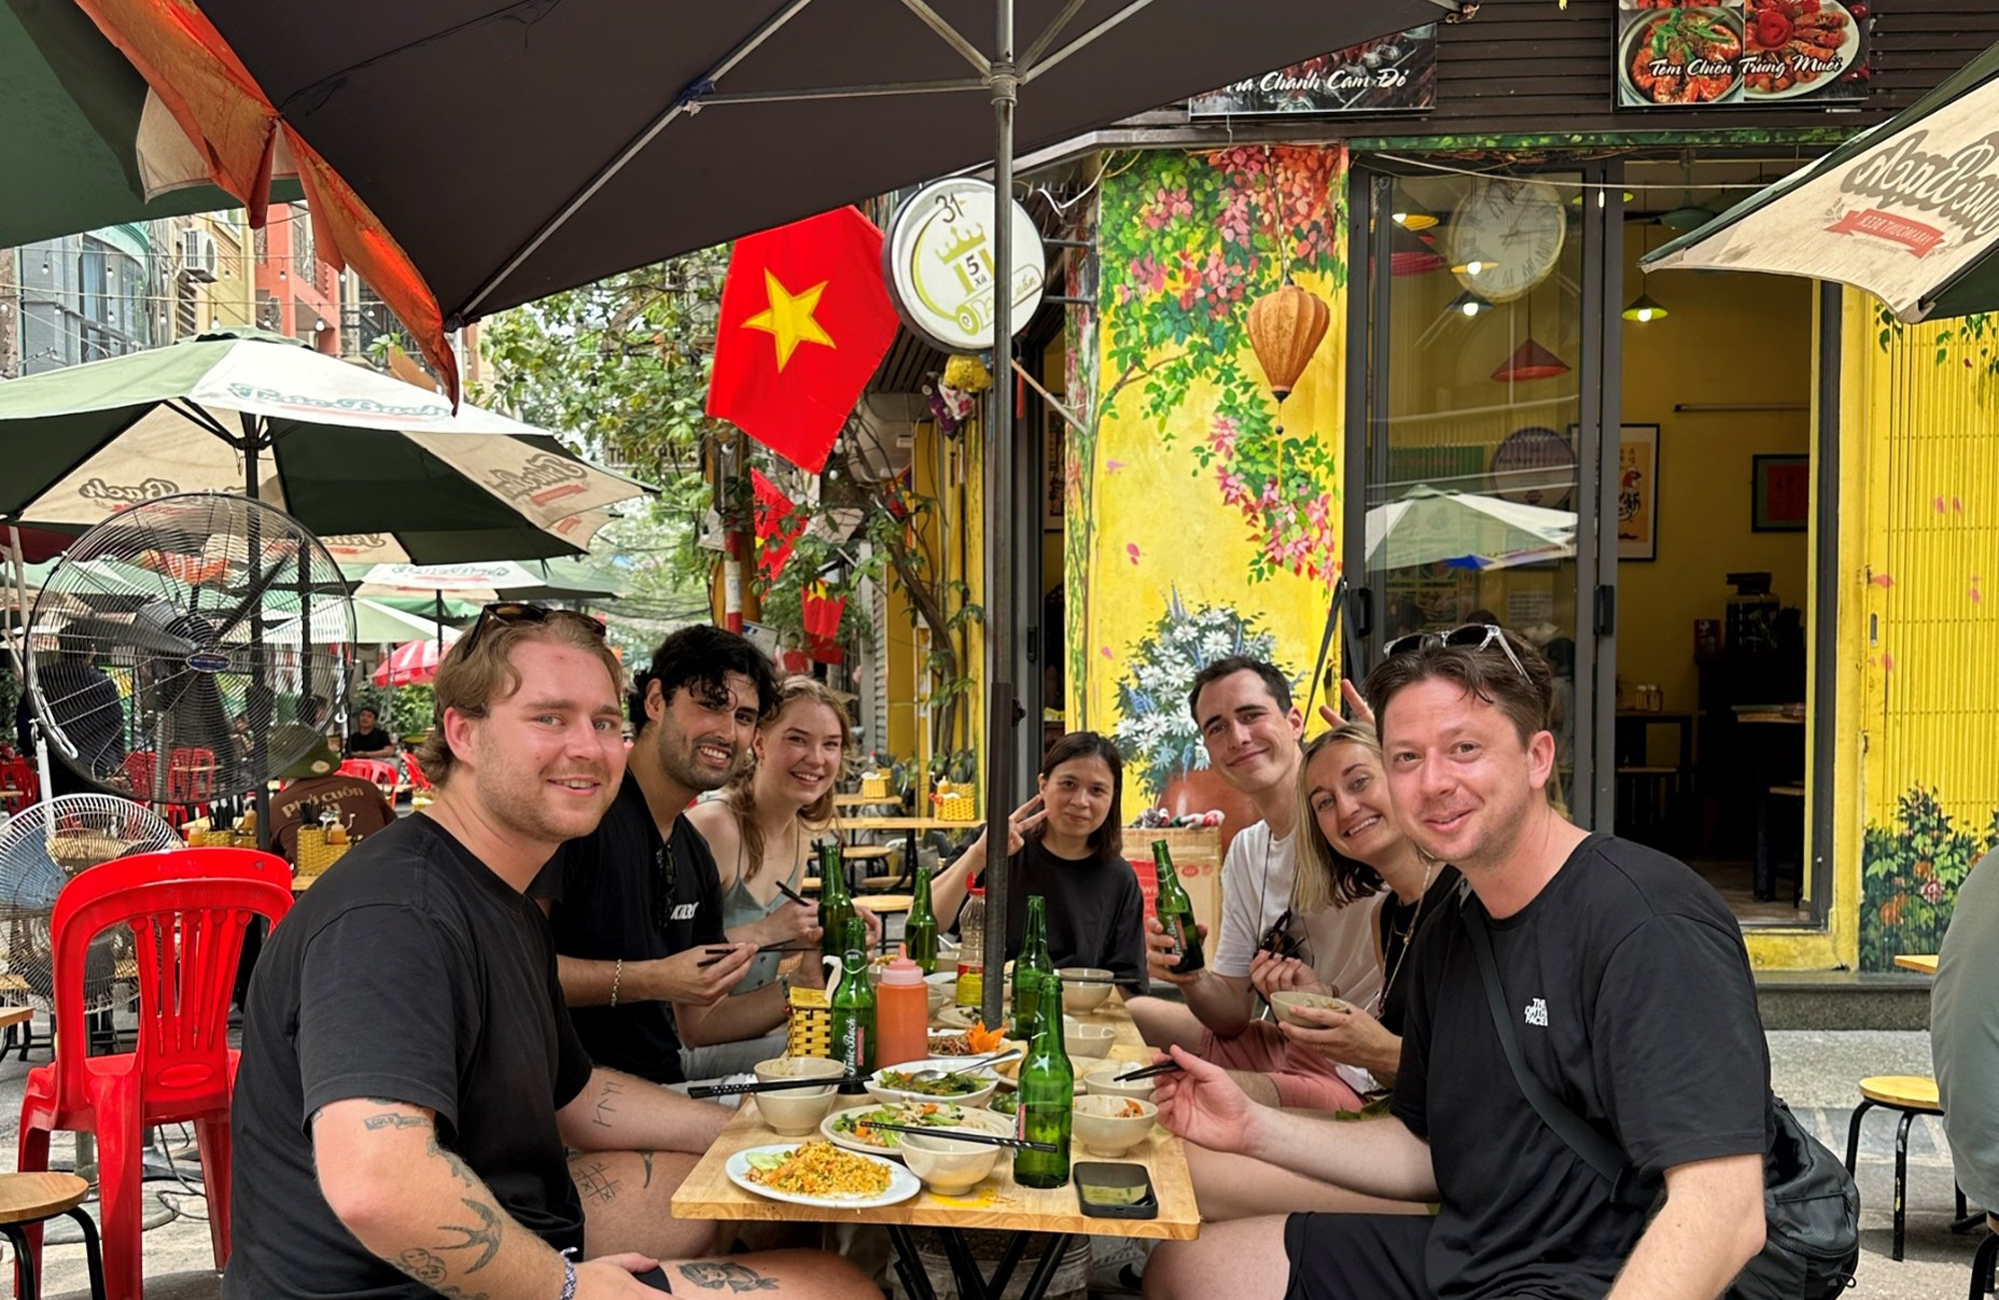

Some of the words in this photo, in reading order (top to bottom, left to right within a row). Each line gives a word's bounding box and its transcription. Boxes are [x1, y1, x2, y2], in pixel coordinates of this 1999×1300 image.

[1327, 69, 1370, 89] Cam
[934, 191, 965, 224] 31
[965, 254, 980, 276] 5
[1532, 998, 1547, 1009] THE
